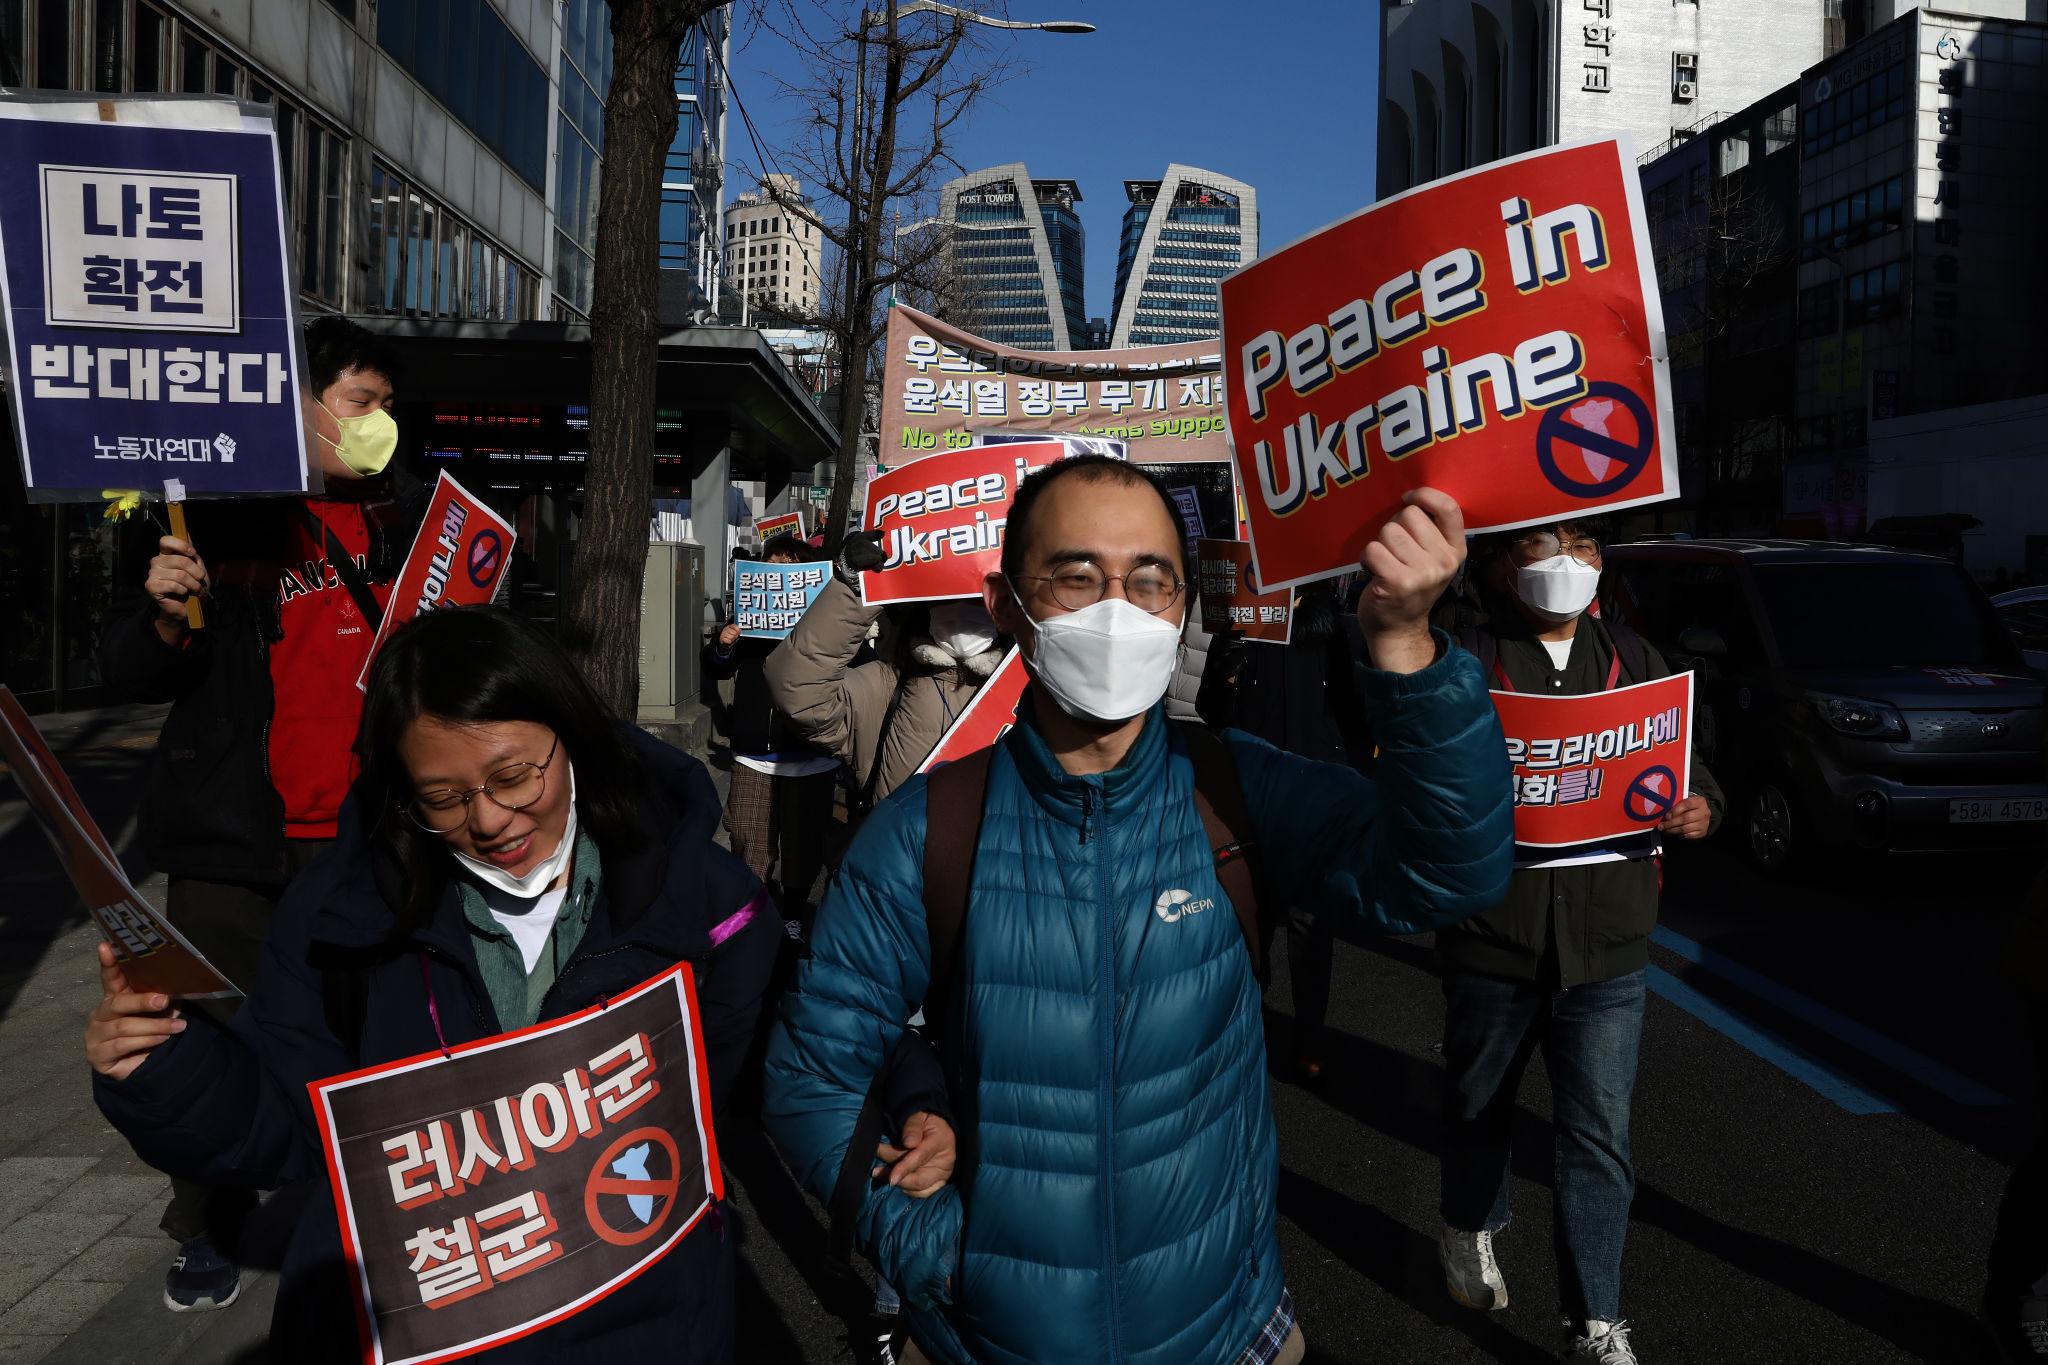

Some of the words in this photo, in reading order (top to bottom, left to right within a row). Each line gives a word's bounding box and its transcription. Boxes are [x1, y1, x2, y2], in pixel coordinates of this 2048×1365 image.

[82, 183, 203, 241] 나토
[960, 195, 981, 204] POST
[984, 194, 1014, 203] TOWER
[83, 254, 203, 314] 확전
[1241, 248, 1487, 424] Peace
[1500, 196, 1610, 295] in
[30, 344, 287, 404] 반대한다
[903, 377, 1008, 416] 윤석열
[1017, 380, 1090, 416] 정부
[1098, 379, 1170, 415] 무기
[902, 426, 936, 448] No
[943, 428, 973, 448] to
[1253, 330, 1588, 517] Ukraine
[93, 435, 212, 462] 노동자연대
[873, 473, 1006, 528] Peace
[872, 511, 1005, 571] Ukrain
[739, 572, 784, 591] 윤석열
[787, 569, 823, 590] 정부
[738, 592, 768, 611] 무기
[772, 591, 807, 610] 지원
[1259, 606, 1287, 624] 말라
[337, 627, 361, 635] CANADA
[737, 612, 803, 631] 반대한다
[2000, 801, 2043, 819] 4578
[1181, 898, 1214, 916] NEPA
[382, 1032, 660, 1210] 러시아군
[405, 1190, 564, 1310] 철군
